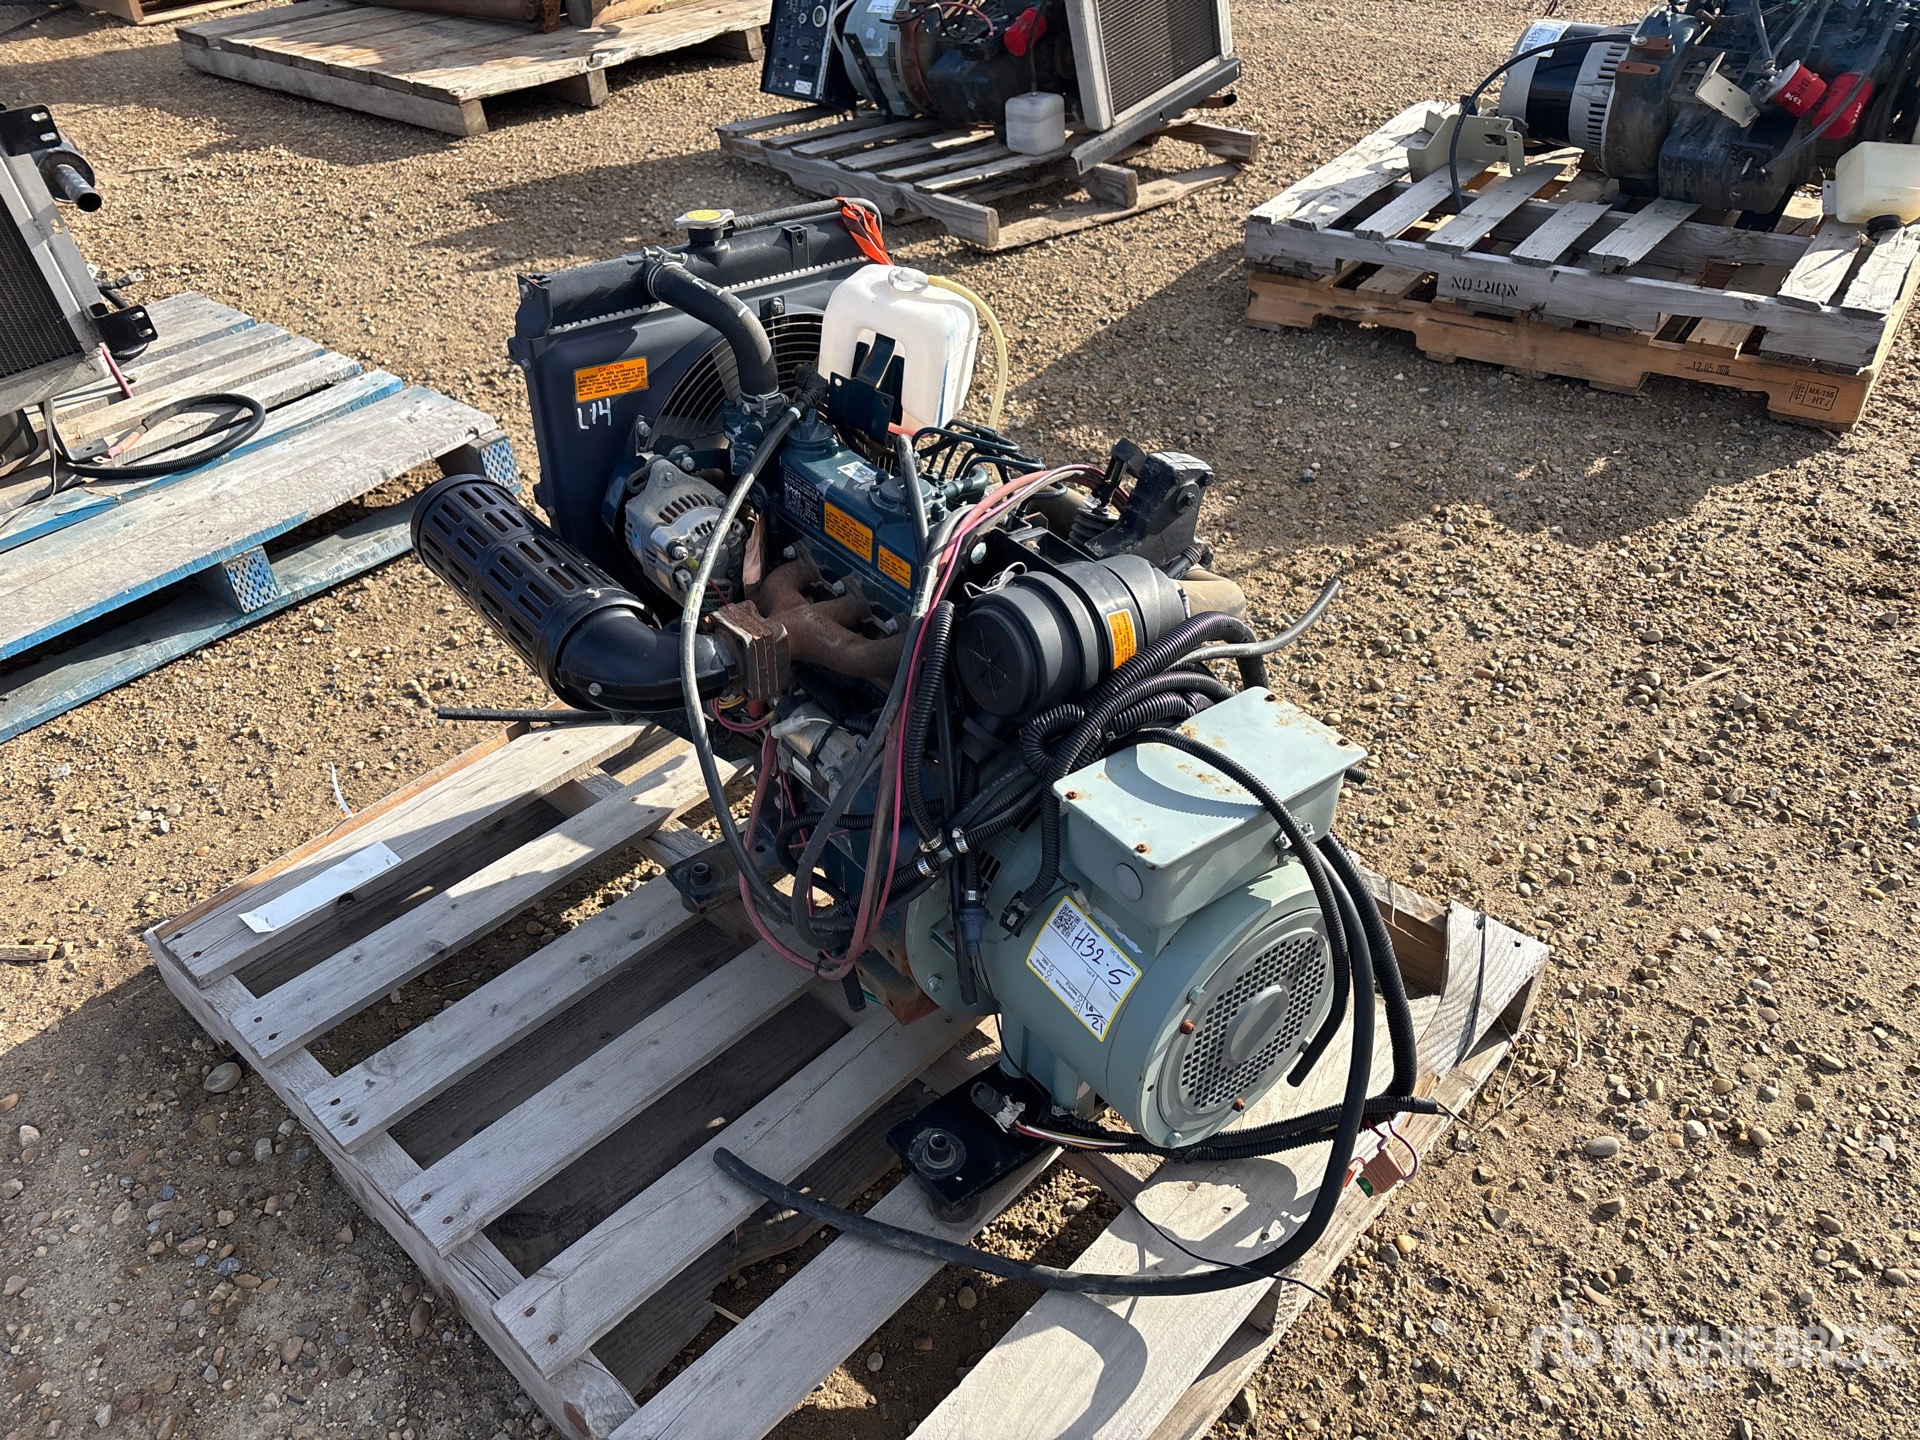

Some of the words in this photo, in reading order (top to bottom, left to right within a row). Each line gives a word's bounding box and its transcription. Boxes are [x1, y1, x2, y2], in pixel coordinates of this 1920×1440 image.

[1452, 275, 1518, 296] NORTON
[598, 364, 624, 373] CAUTION
[1809, 387, 1835, 398] MX-155
[1056, 979, 1075, 1001] Inspection
